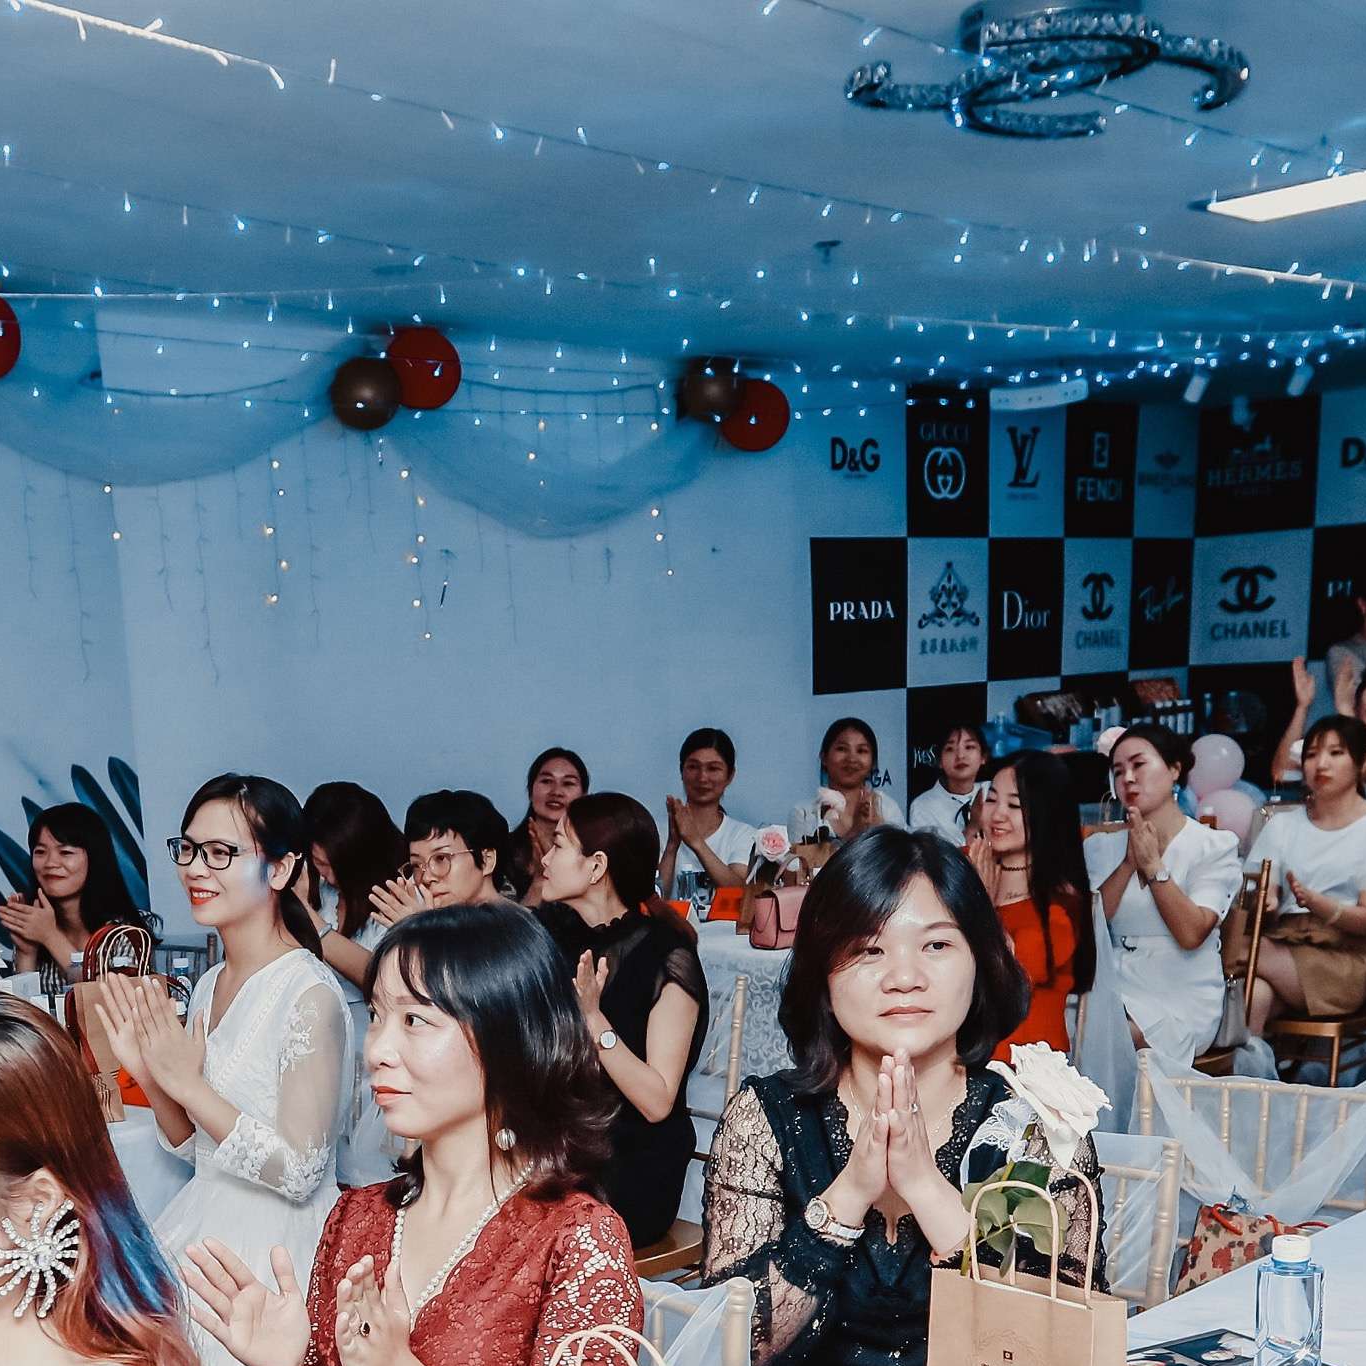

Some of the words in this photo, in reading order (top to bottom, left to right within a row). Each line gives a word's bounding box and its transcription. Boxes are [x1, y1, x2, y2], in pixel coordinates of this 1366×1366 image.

[830, 437, 881, 473] D&G
[1076, 477, 1123, 501] FENDI
[829, 600, 894, 621] PRADA
[1002, 590, 1051, 631] Dior
[1075, 630, 1122, 650] CHANEL
[1210, 618, 1291, 642] CHANEL
